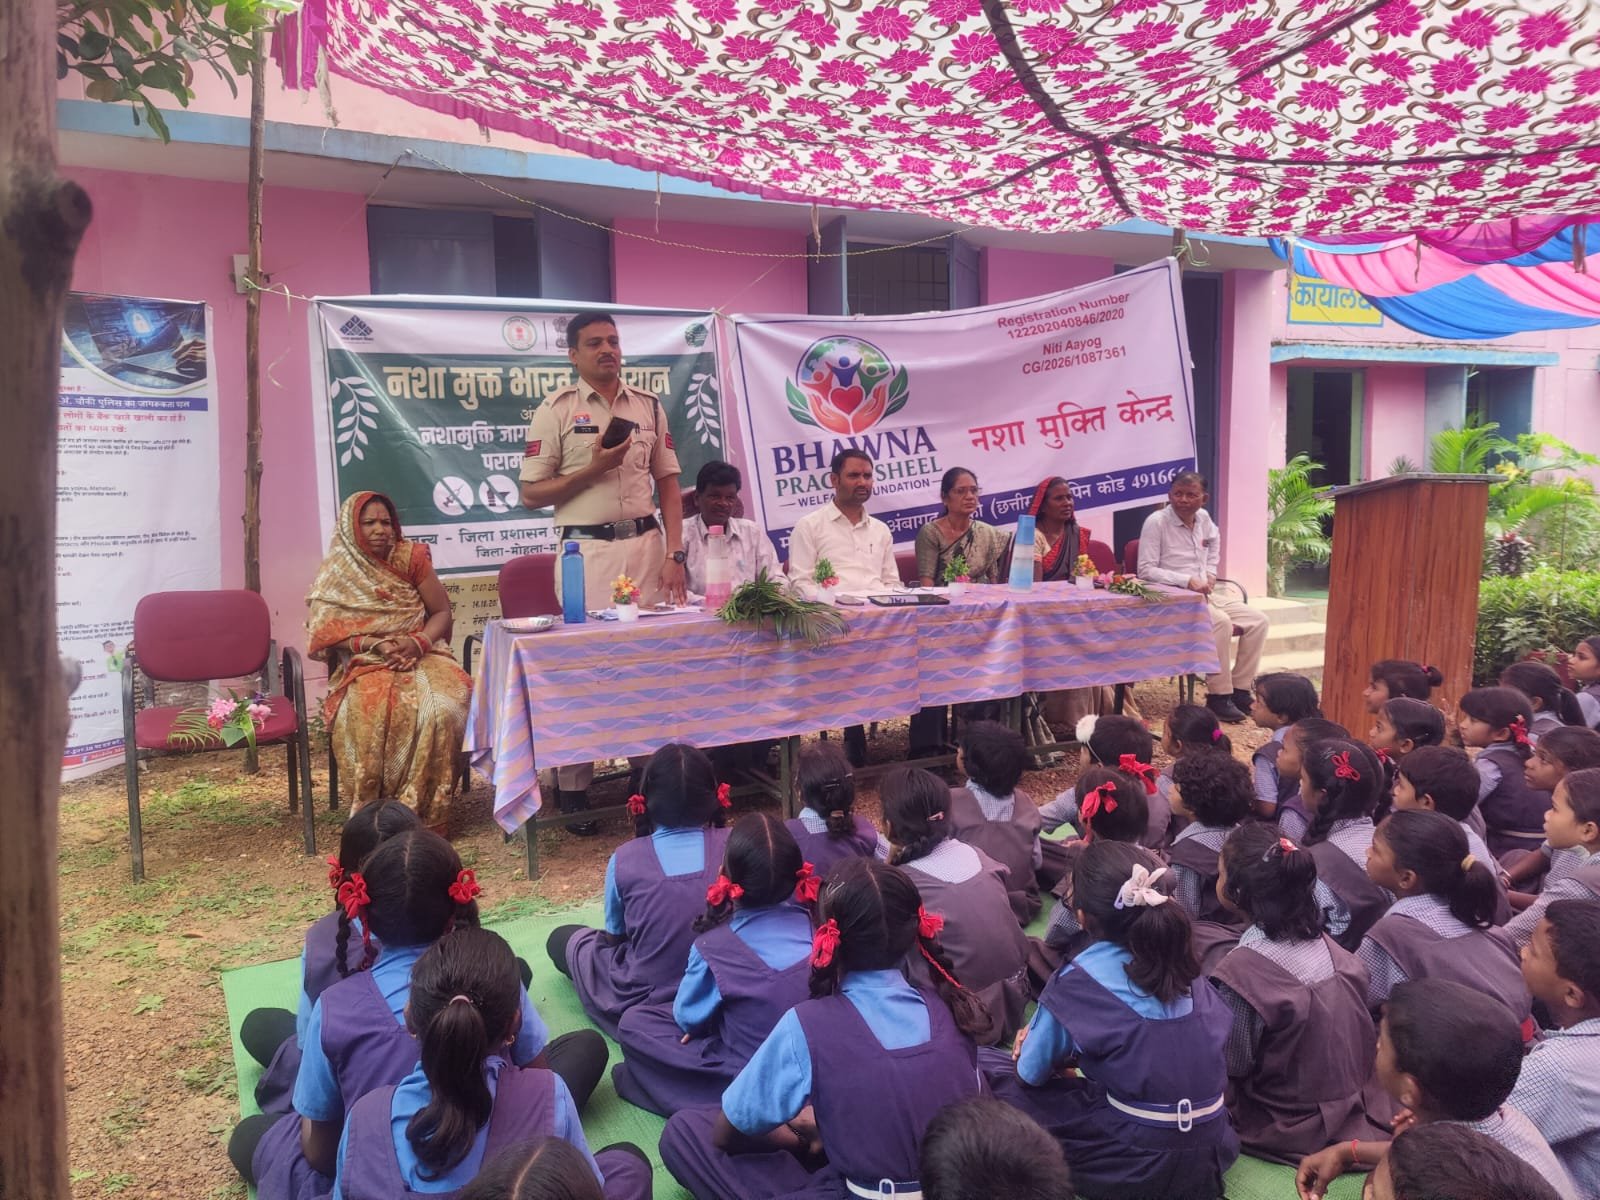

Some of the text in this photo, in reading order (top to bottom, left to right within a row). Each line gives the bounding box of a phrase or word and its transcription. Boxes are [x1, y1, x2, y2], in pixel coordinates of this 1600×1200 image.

[997, 293, 1131, 328] Registration Number
[1007, 307, 1125, 339] 122202040846/2020
[1022, 345, 1127, 374] CG/2026/1087361
[1042, 337, 1102, 355] Niti Aayog
[383, 366, 447, 399] नशा
[450, 366, 503, 410] मुक्त
[968, 390, 1175, 451] नशा मुक्ति केन्द्र
[418, 421, 495, 450] नशामुक्ति
[771, 426, 938, 476] BHAWNA
[871, 478, 931, 497] UNDATION
[1096, 474, 1126, 495] कोड
[459, 528, 494, 544] जिला
[500, 527, 548, 542] प्रशासन
